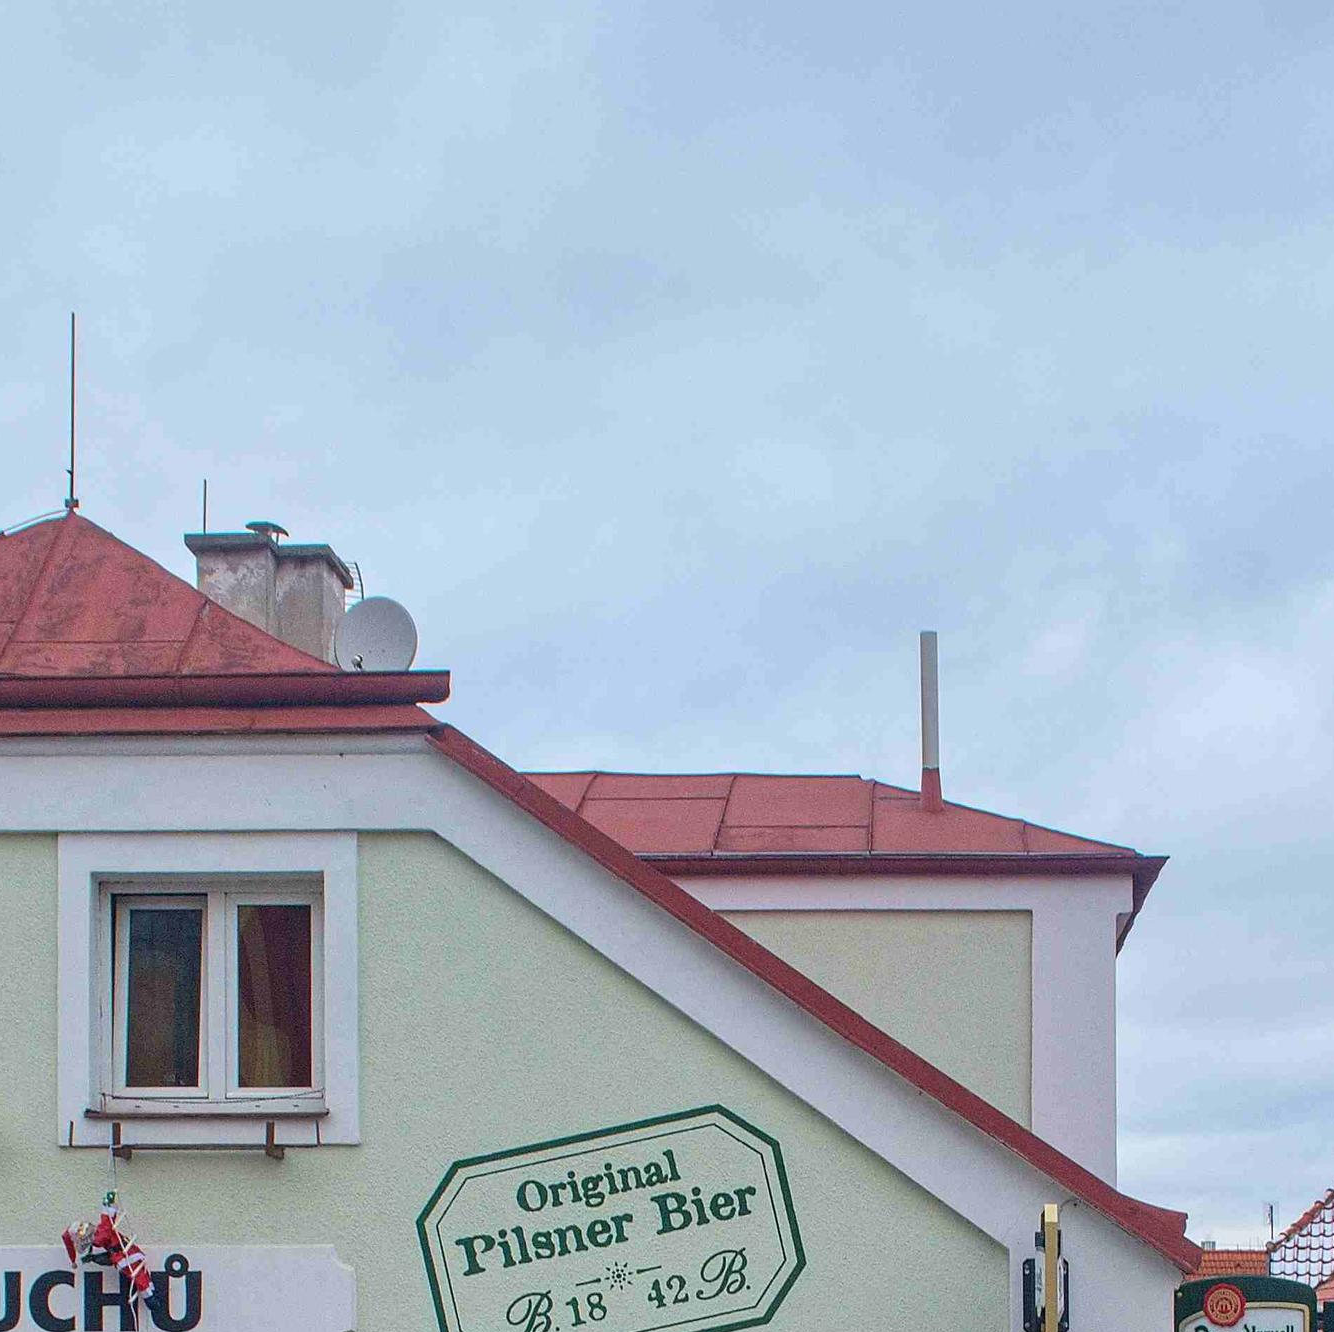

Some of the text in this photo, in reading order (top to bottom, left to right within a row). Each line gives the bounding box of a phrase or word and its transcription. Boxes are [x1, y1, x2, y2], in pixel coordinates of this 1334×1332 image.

[517, 1149, 682, 1213] Original
[455, 1184, 758, 1277] Pilsner Bier
[565, 1291, 608, 1328] 18
[646, 1273, 691, 1309] 42
